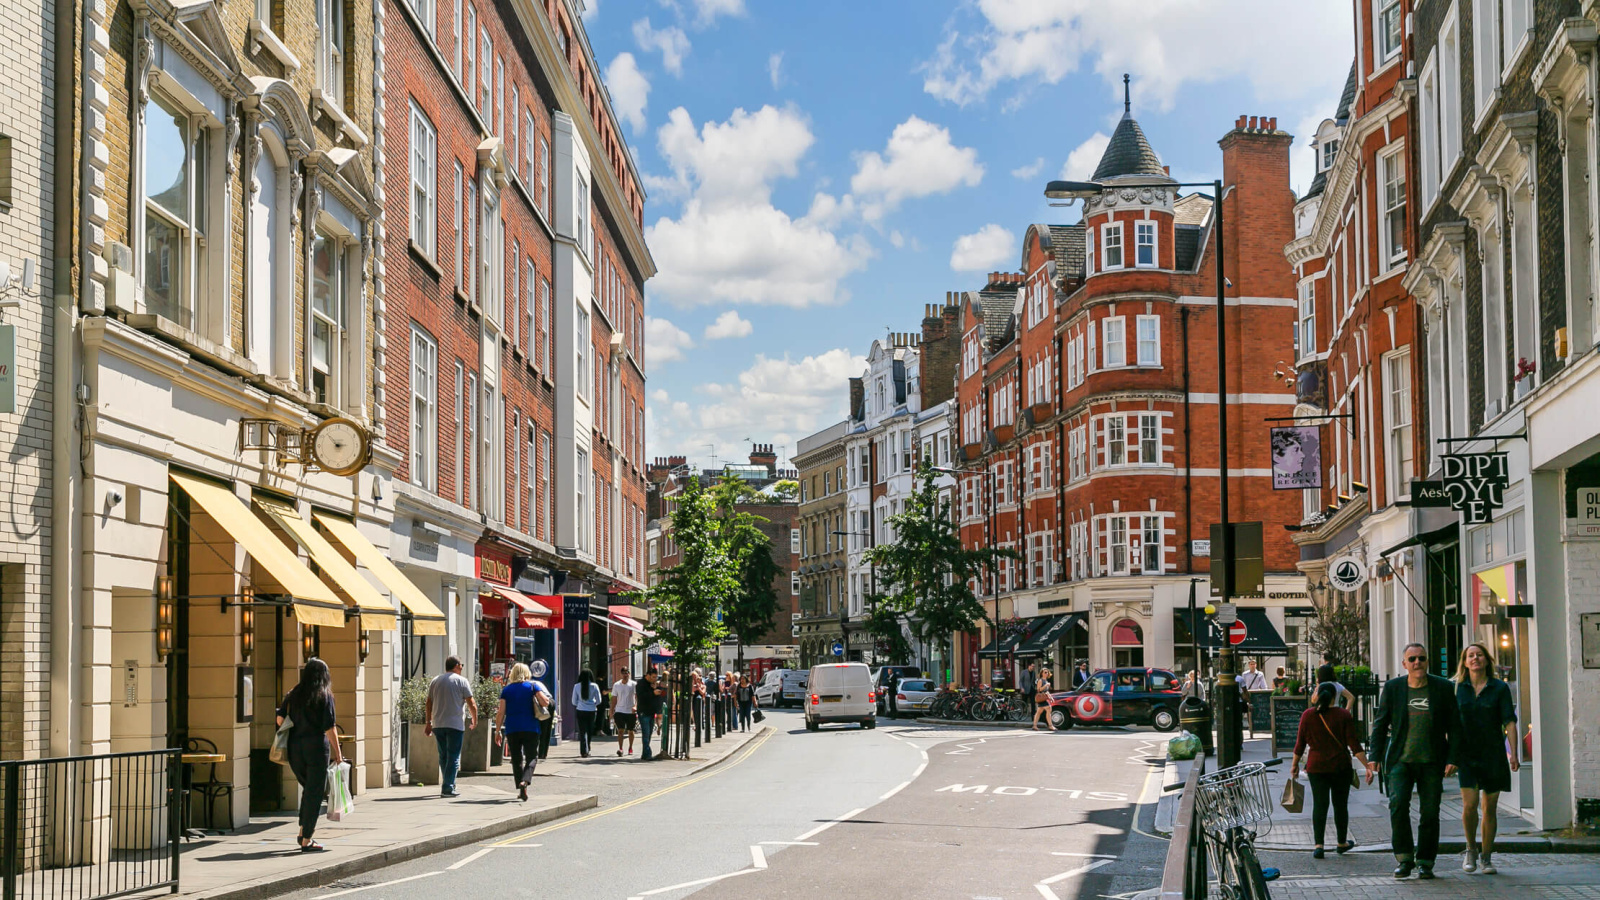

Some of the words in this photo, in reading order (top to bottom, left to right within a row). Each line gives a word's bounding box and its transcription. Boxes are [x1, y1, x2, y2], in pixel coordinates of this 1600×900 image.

[1443, 455, 1507, 478] DIPT
[1332, 575, 1345, 588] PETIT
[1346, 574, 1364, 588] BATEAU
[934, 783, 1128, 801] SLOW
